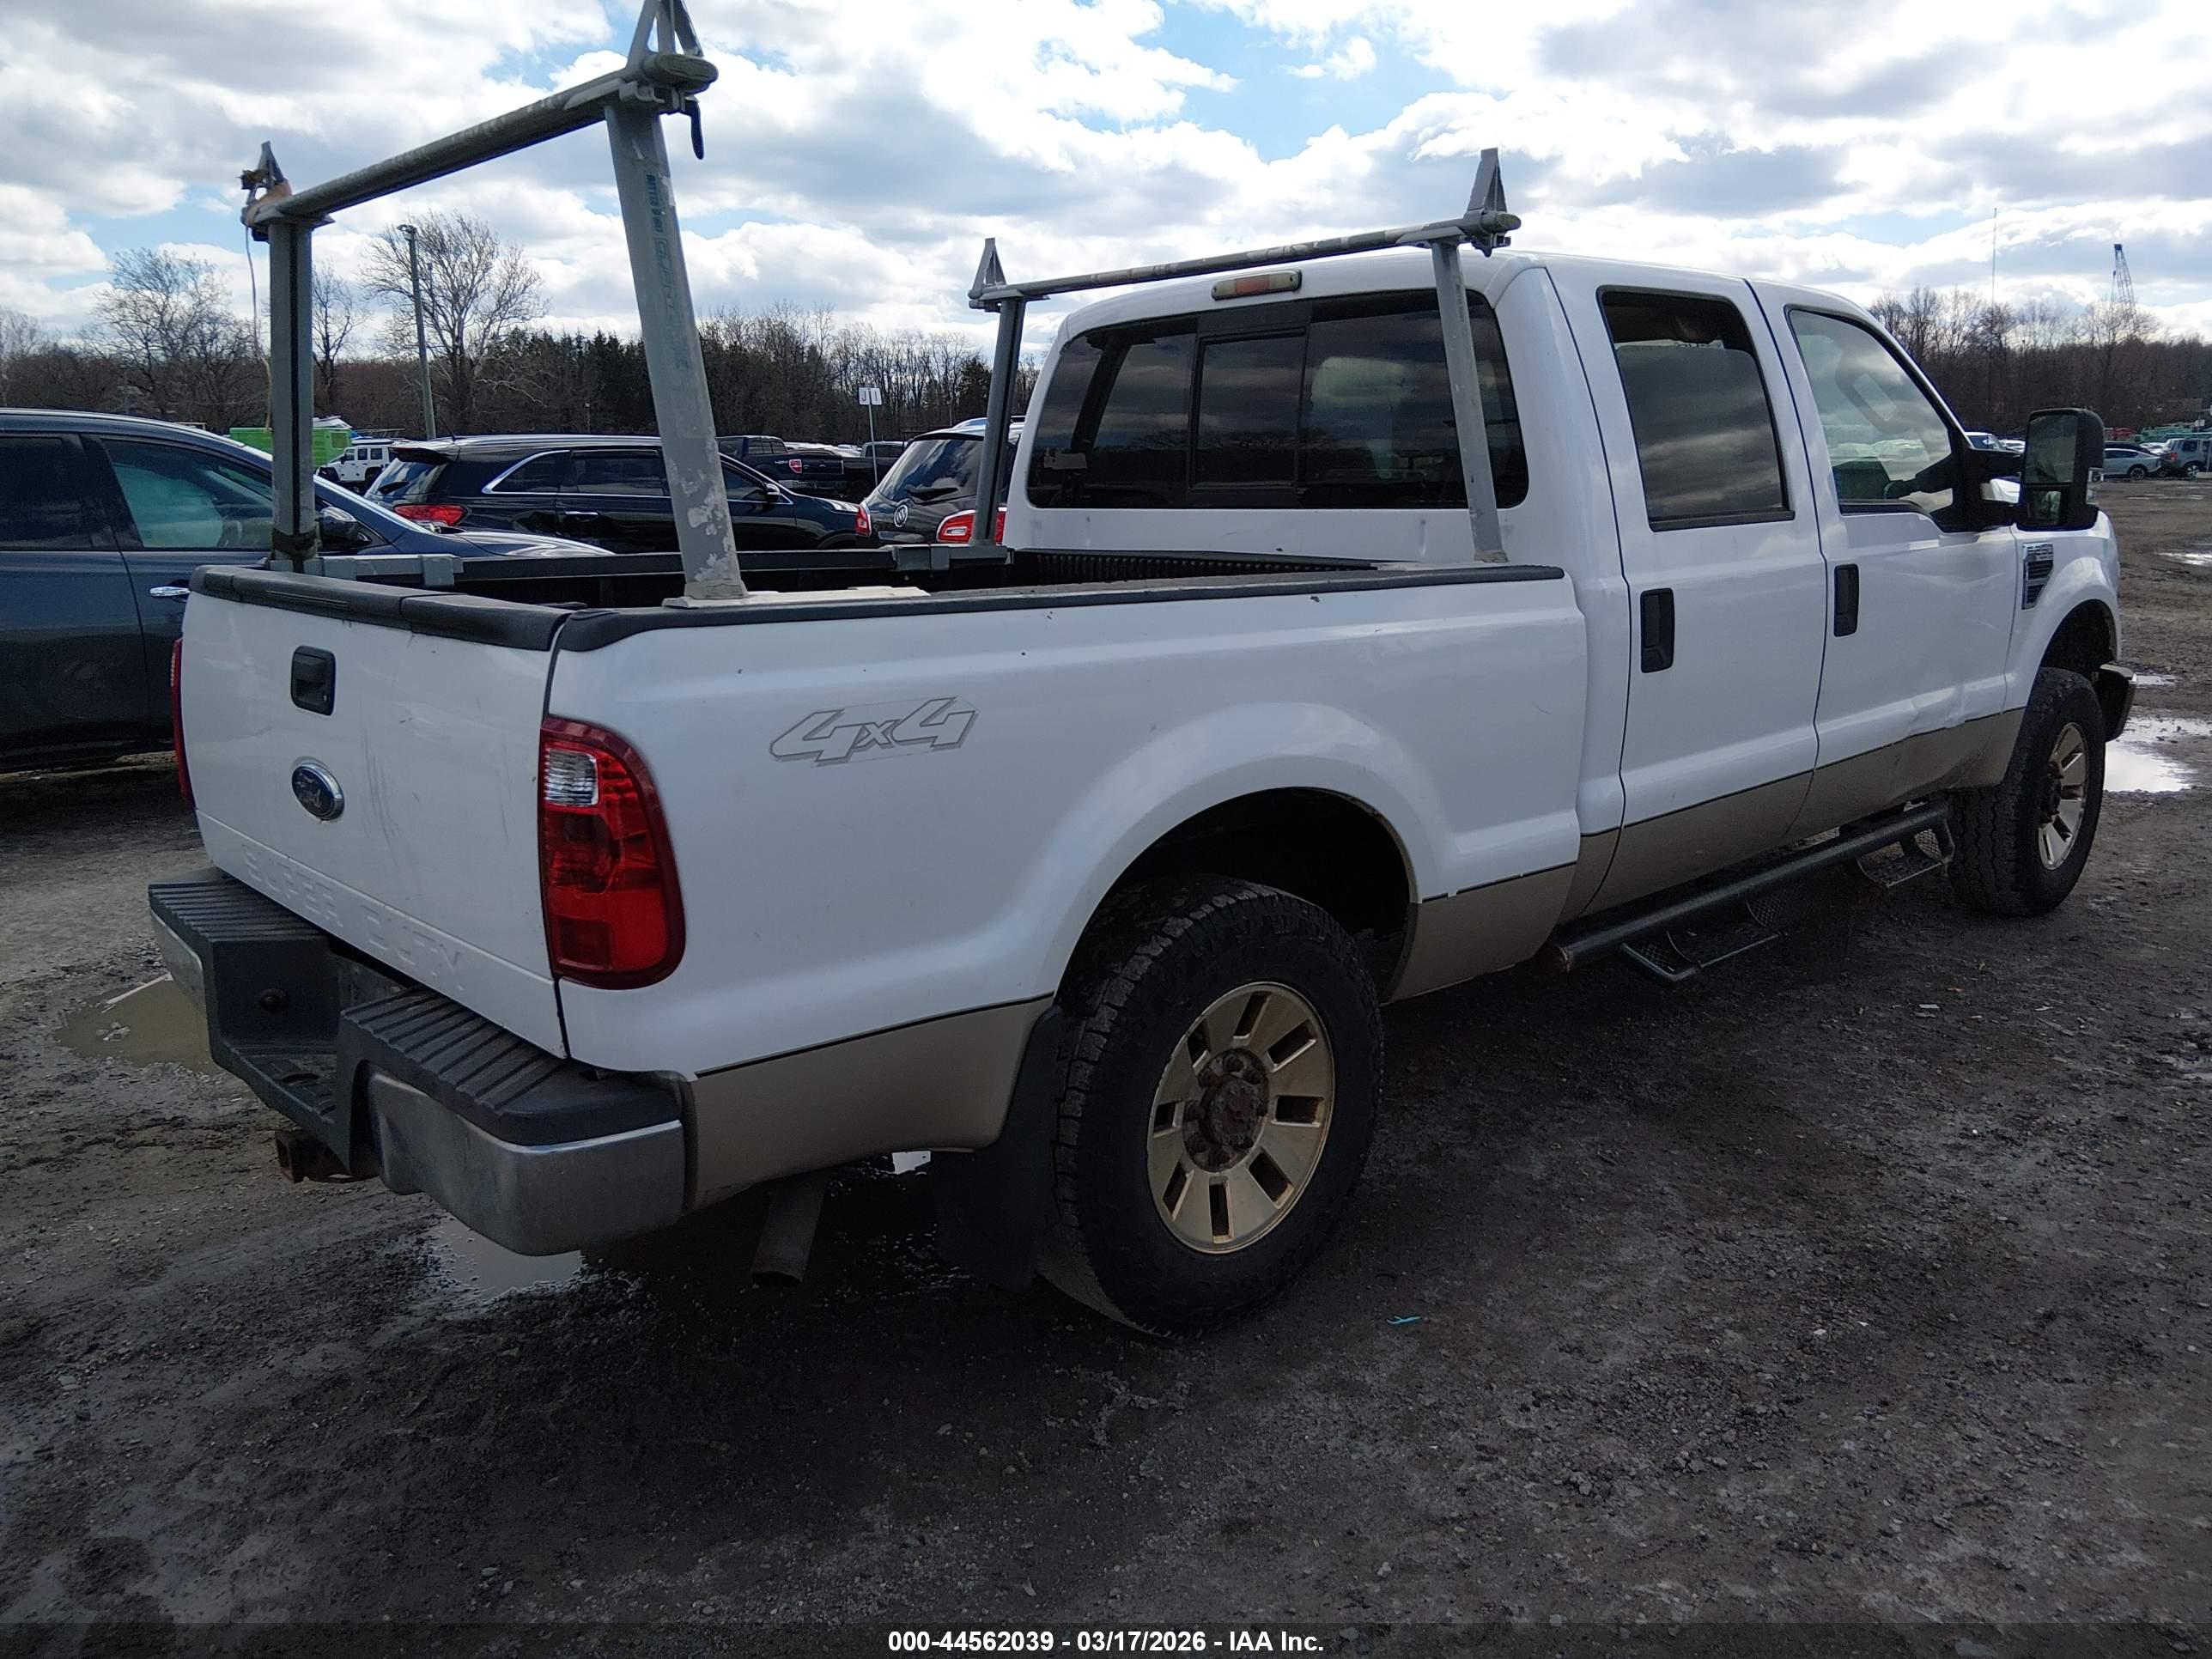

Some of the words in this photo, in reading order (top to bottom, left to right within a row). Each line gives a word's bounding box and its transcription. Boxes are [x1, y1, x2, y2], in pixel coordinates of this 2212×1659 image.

[770, 696, 979, 767] 4x4
[240, 844, 343, 927] SUPER
[360, 904, 465, 990] DUTY
